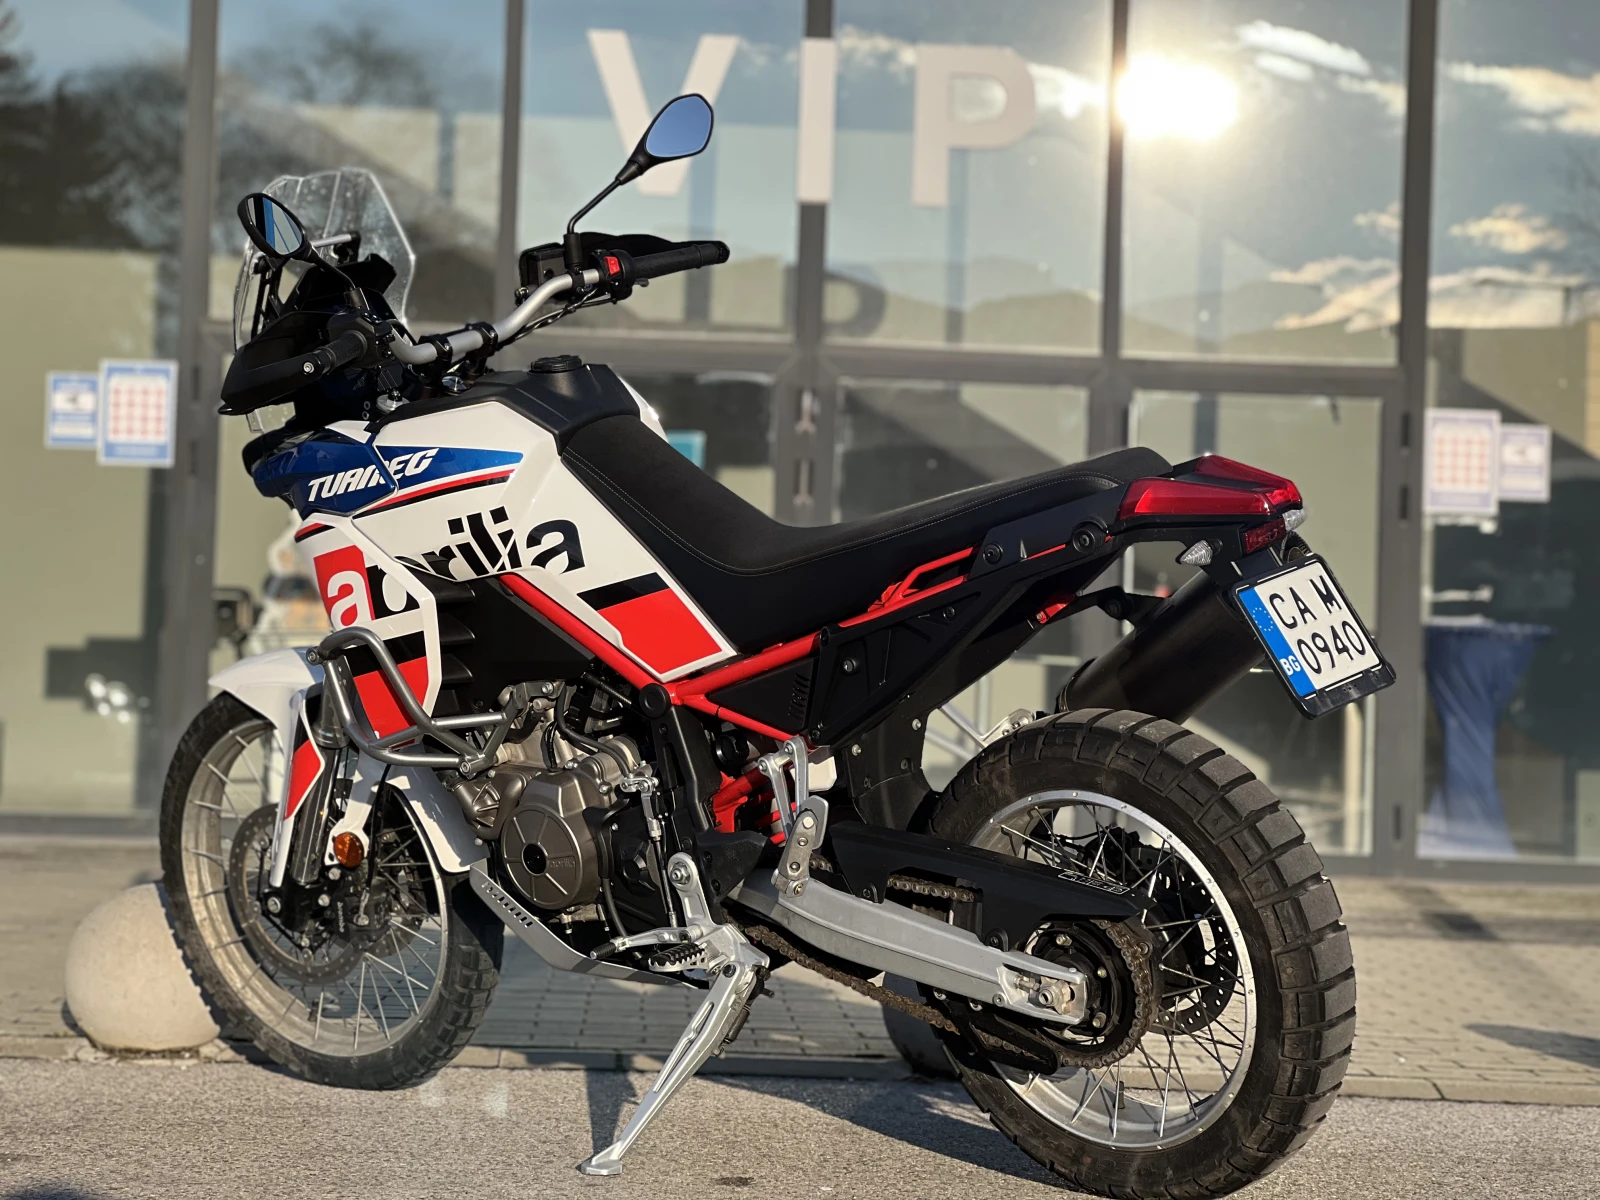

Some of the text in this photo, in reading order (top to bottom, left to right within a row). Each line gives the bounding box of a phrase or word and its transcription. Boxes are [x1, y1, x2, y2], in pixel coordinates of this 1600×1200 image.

[586, 28, 1037, 209] VIP
[308, 447, 440, 502] TUAREG
[1268, 576, 1342, 629] CA M
[1279, 654, 1301, 676] BG
[1296, 620, 1367, 675] 0940
